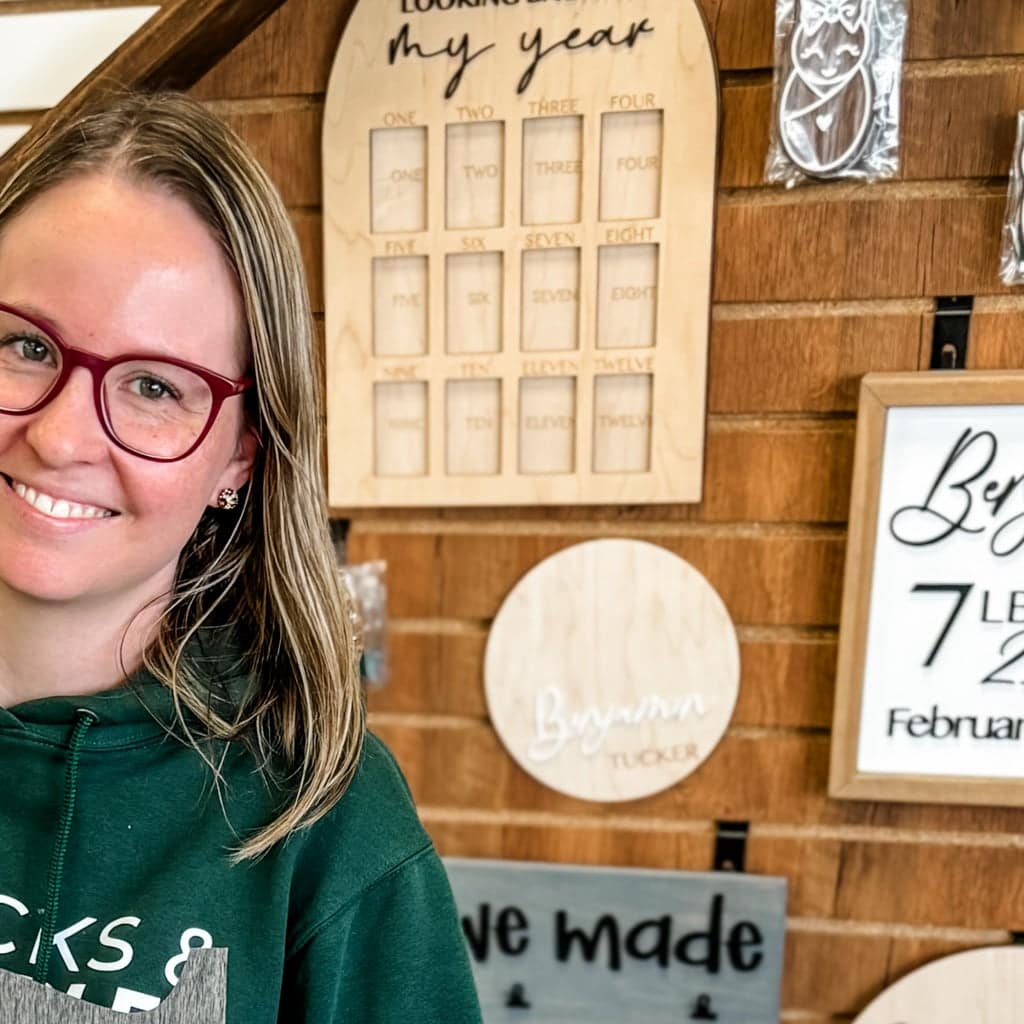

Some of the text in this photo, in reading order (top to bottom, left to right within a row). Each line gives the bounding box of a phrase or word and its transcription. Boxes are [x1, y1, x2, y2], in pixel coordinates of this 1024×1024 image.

[516, 18, 654, 94] year
[383, 93, 655, 126] ONE TWO THREE FOUR
[390, 156, 660, 183] ONE TWO THREE FOUR
[385, 227, 655, 254] FIVE SIX SEVEN EIGHT
[910, 583, 975, 667] 7
[554, 894, 765, 974] made
